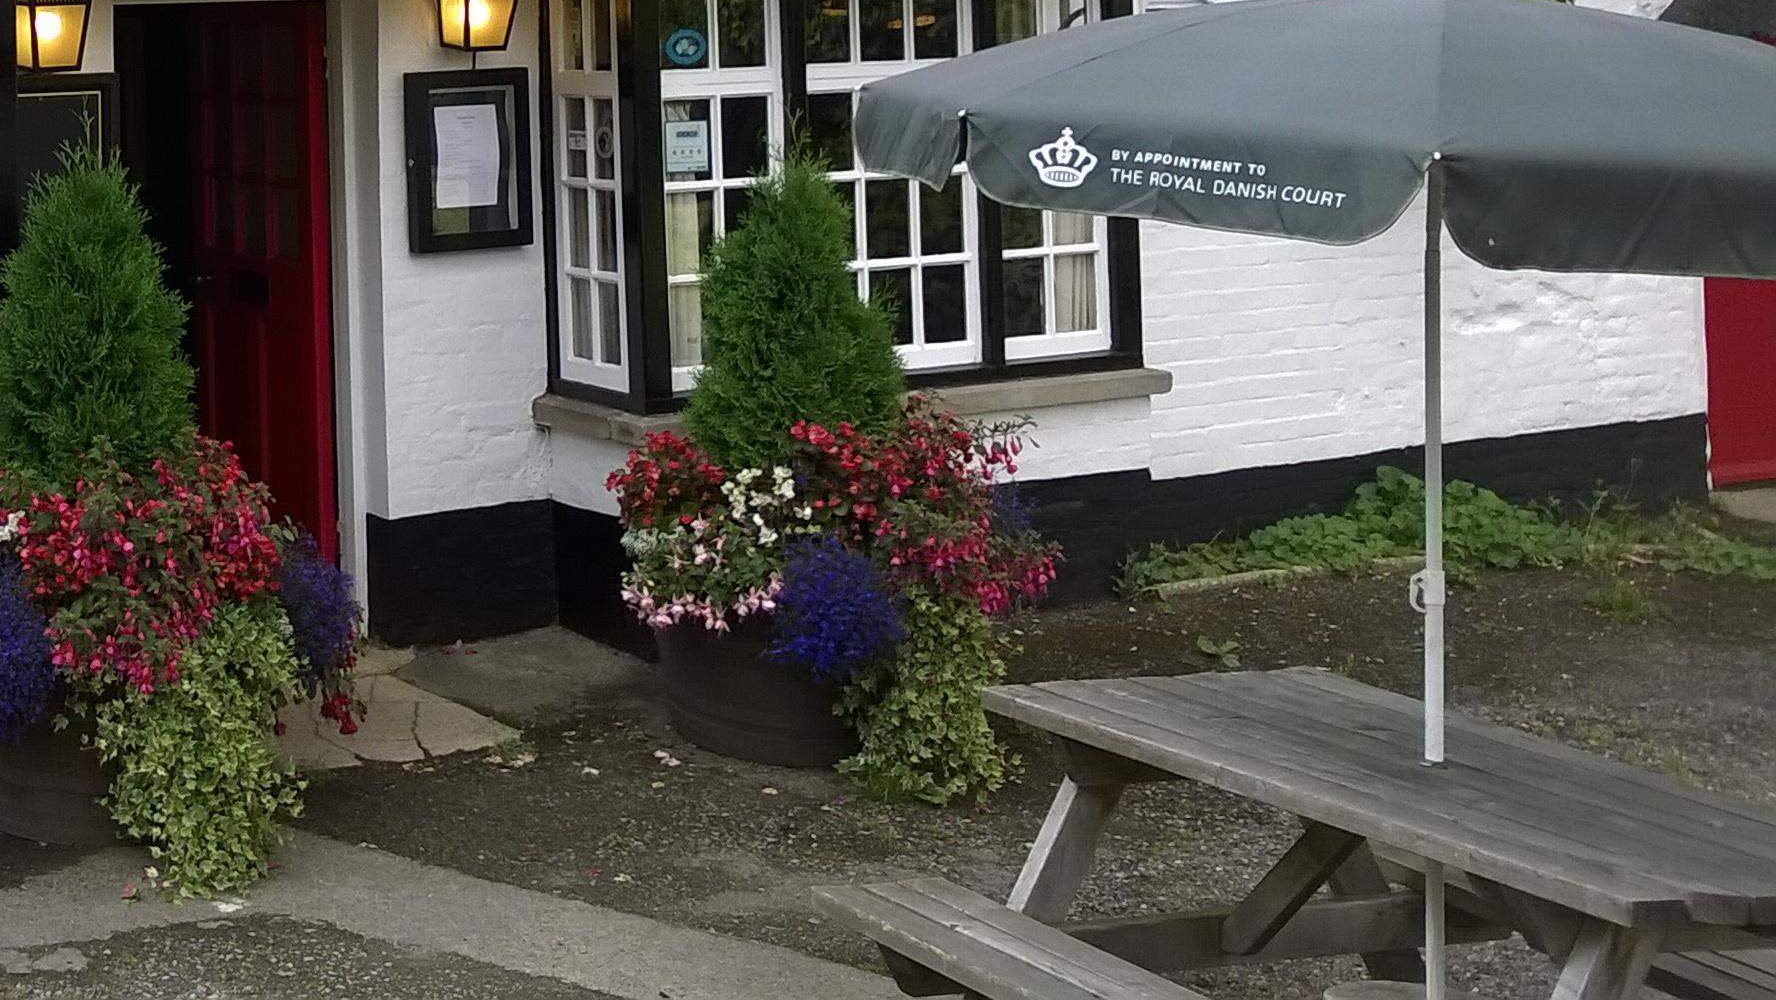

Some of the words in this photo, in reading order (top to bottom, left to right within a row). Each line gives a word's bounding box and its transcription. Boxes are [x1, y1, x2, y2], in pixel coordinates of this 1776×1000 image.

[1111, 149, 1130, 162] BY
[1134, 151, 1242, 176] APPOINTMENT
[1247, 163, 1266, 177] TO
[1110, 167, 1143, 186] THE
[1149, 171, 1206, 195] ROYAL
[1212, 178, 1277, 201] DANISH
[1280, 185, 1348, 210] COURT
